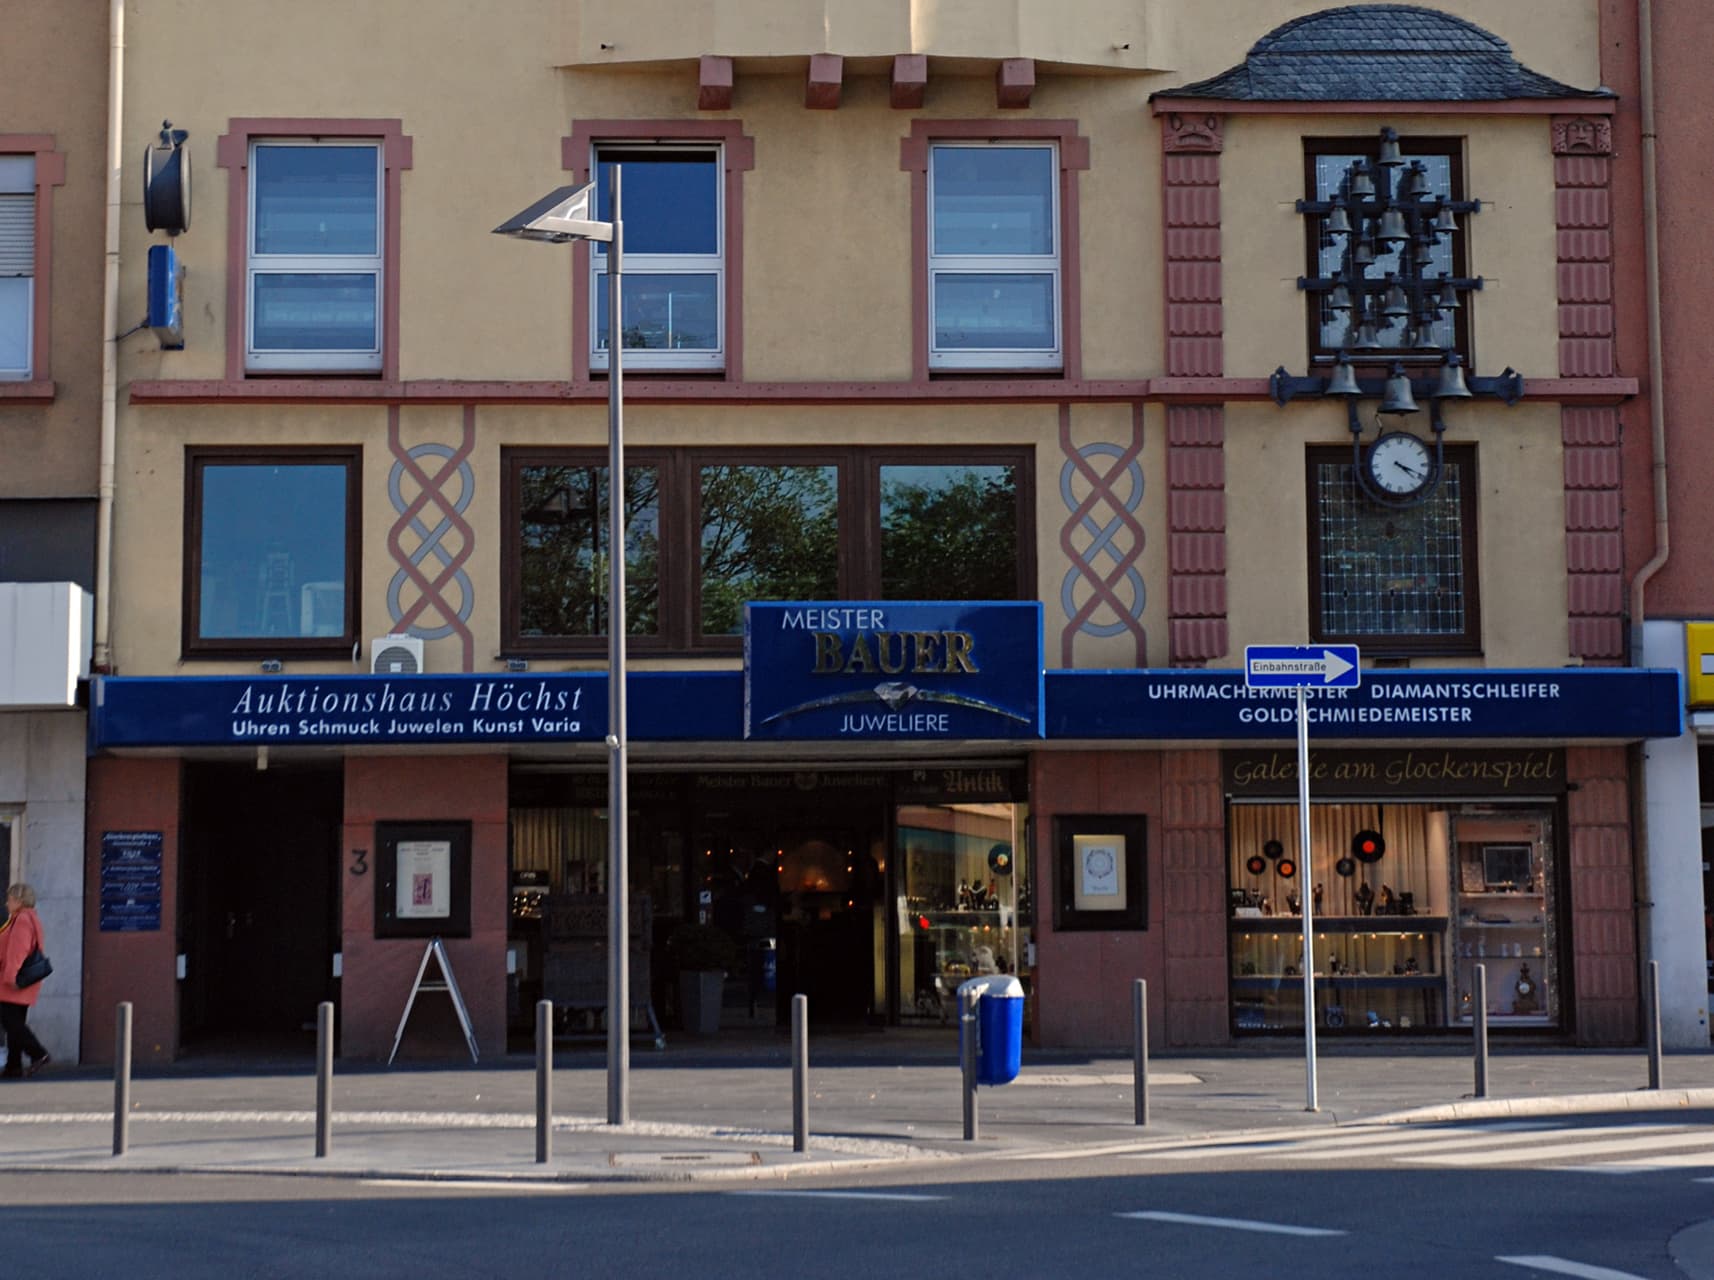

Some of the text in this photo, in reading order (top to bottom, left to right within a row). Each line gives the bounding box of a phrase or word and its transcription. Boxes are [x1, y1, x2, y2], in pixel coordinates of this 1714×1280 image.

[782, 609, 885, 629] MEISTER
[812, 630, 980, 673] BAUER
[1252, 662, 1327, 672] Einbahnstraße
[232, 681, 583, 713] Auktionshaus Höchst
[1148, 683, 1560, 699] UHRMACHERMESTER DIAMANTSCHLEIFER
[232, 717, 581, 735] Uhren Schmuck Juwelen Kunst Varia
[840, 714, 949, 732] JUWELIERE
[1334, 761, 1377, 779] am
[1385, 751, 1558, 787] Glockenspiel
[350, 849, 368, 875] 3
